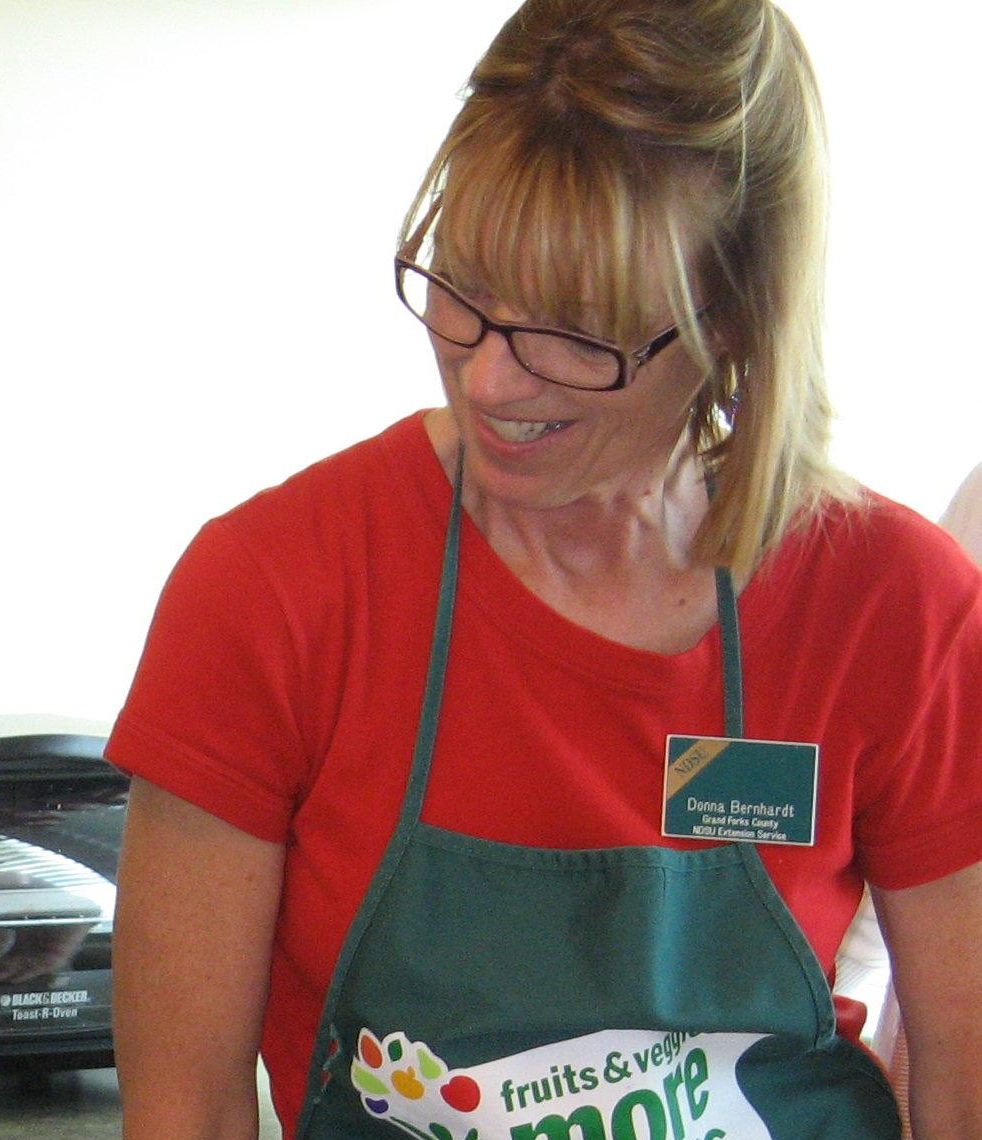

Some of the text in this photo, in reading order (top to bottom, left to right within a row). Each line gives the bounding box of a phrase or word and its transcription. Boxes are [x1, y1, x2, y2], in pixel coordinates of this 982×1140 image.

[687, 797, 795, 818] Donna Bernhardt
[702, 814, 779, 830] Grand Forks County
[692, 825, 787, 840] NDSU Extension Service
[12, 1007, 78, 1020] Toast-R-Oven
[500, 1031, 702, 1113] fruits & vegg
